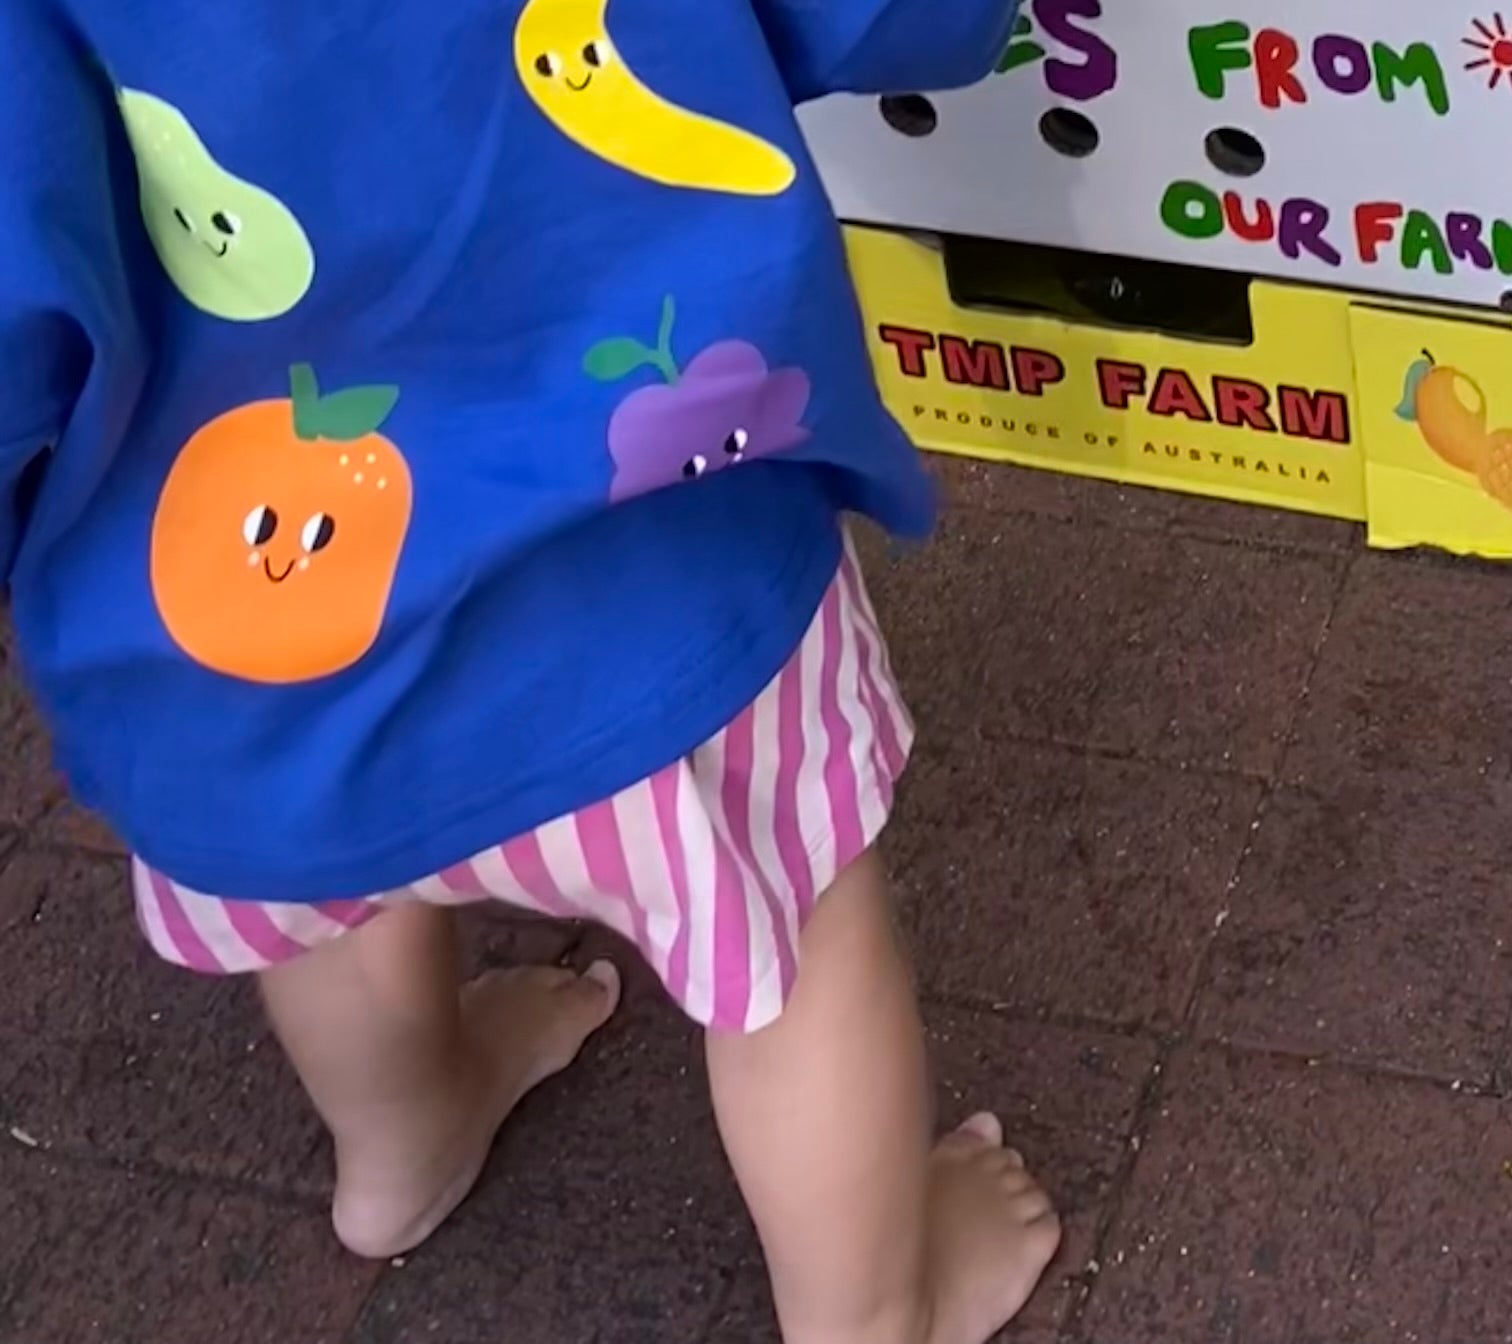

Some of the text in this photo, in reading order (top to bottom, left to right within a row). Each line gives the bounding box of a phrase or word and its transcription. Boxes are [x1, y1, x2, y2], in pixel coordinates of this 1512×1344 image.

[1188, 21, 1450, 116] FROM
[1160, 179, 1341, 267] OUR
[879, 324, 1352, 445] TMP FARM
[913, 404, 1332, 484] PRODUCE OF AUSTRALIA
